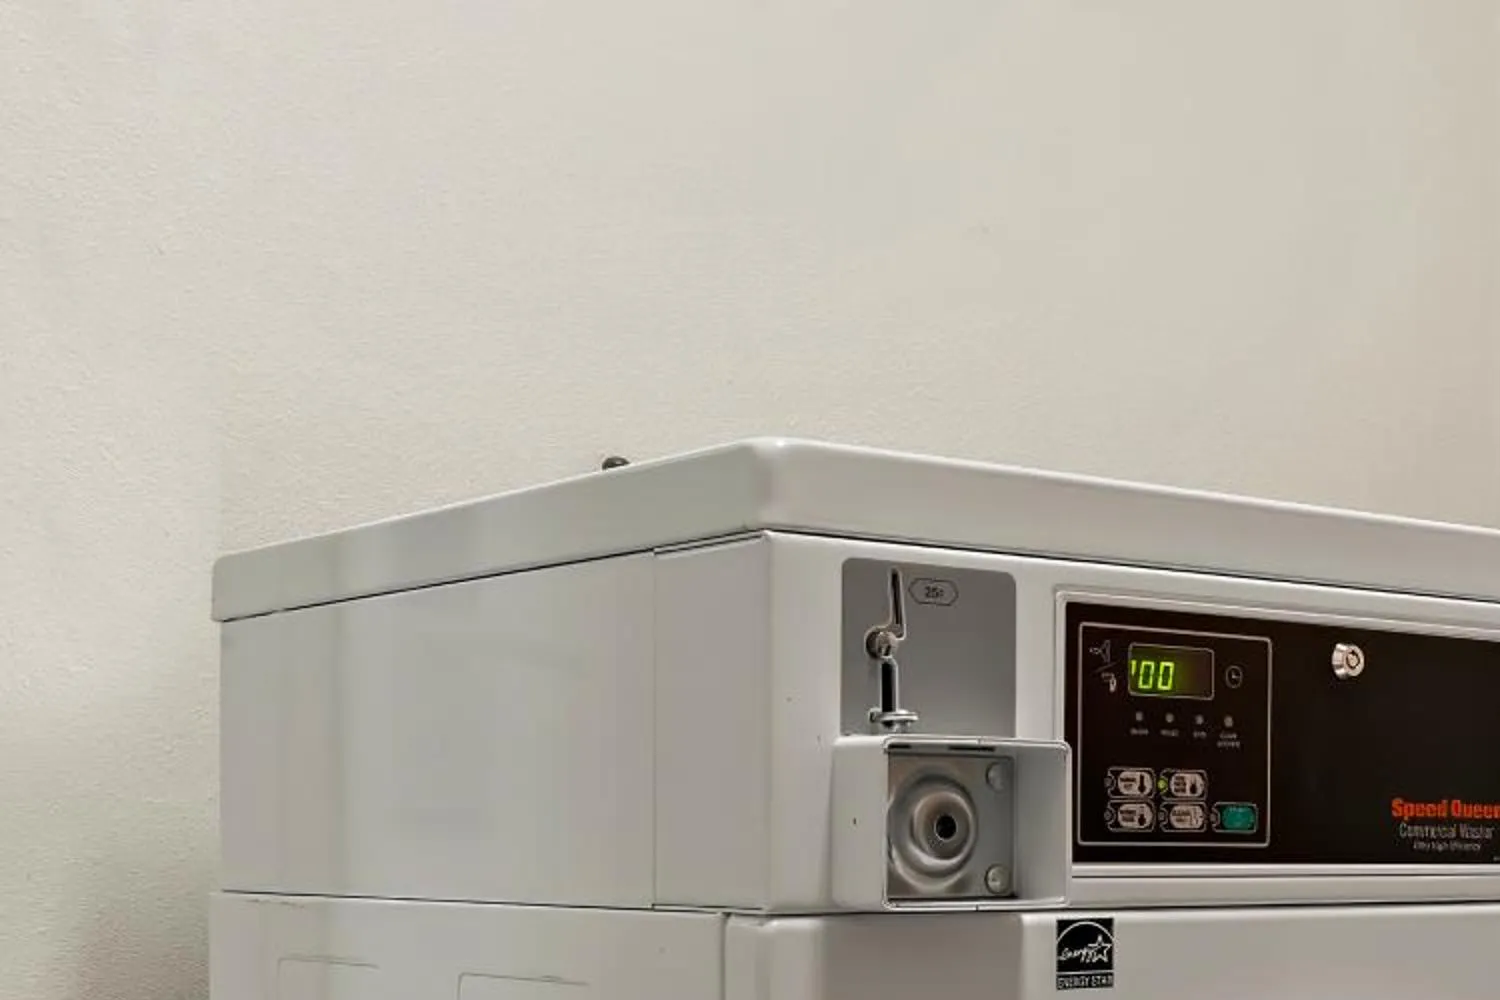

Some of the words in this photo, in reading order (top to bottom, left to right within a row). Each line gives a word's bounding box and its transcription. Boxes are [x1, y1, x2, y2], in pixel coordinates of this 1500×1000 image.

[1391, 798, 1448, 821] Speed
[1399, 823, 1456, 839] Commercial
[1058, 976, 1089, 989] ENERGY
[1091, 975, 1113, 987] STAR
